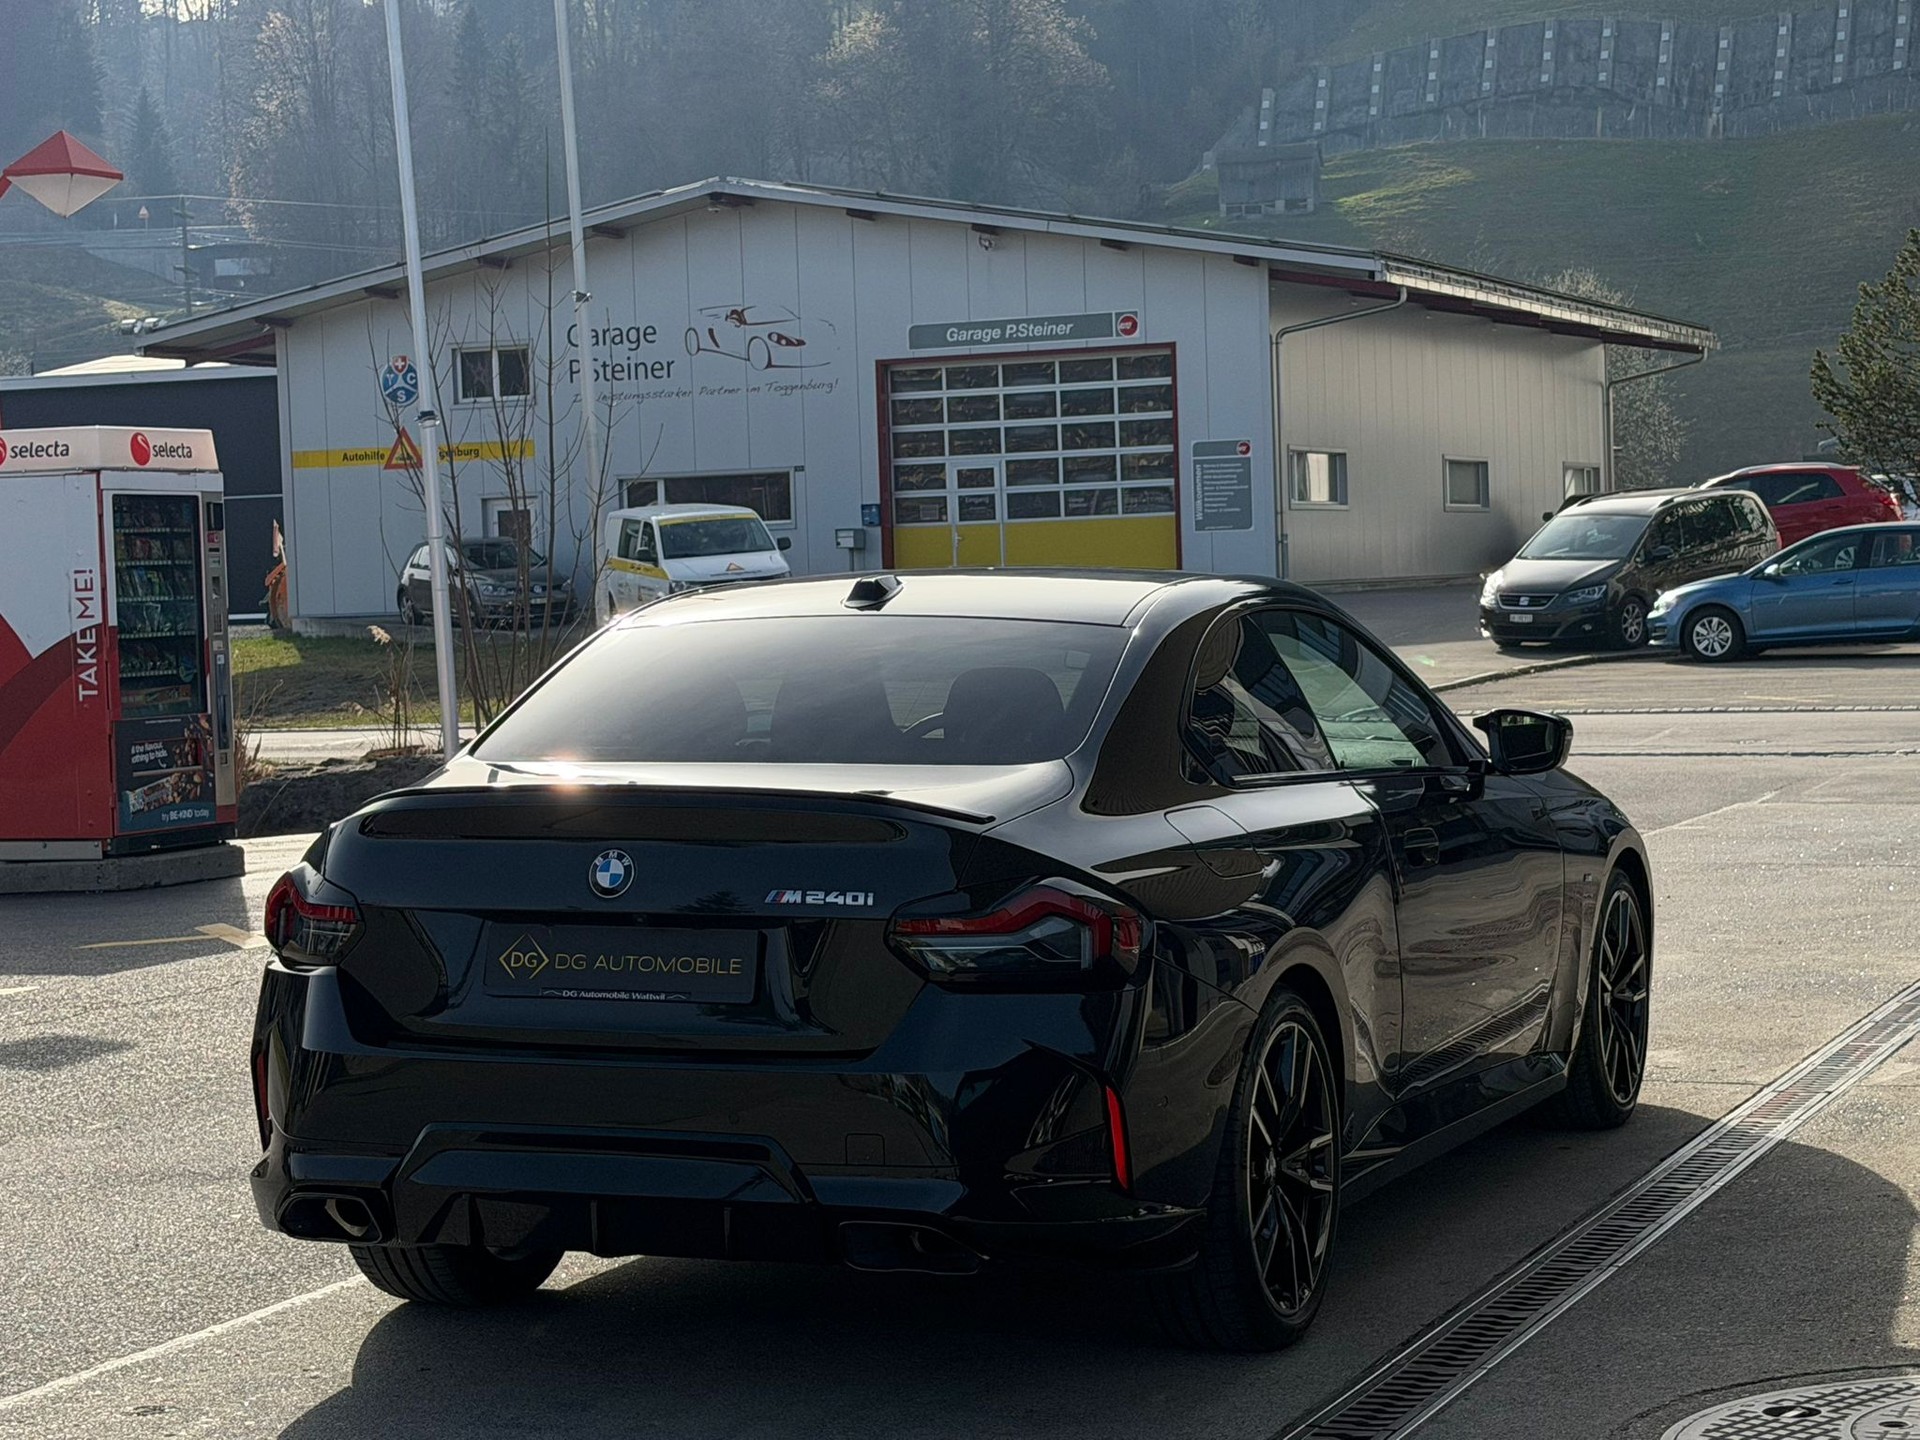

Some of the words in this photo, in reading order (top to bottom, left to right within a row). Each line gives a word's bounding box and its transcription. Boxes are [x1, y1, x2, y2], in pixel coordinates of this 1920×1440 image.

[567, 324, 657, 351] Garage
[946, 327, 1001, 342] Garage
[1005, 321, 1074, 338] P.Steiner
[765, 378, 839, 396] Toggenburg!
[9, 441, 70, 459] selecta
[152, 442, 192, 459] selecta
[342, 450, 386, 462] Autohilfe
[74, 568, 96, 619] ME!
[77, 627, 99, 702] TAKE
[510, 951, 538, 967] DG
[554, 953, 587, 970] DG
[593, 954, 743, 975] AUTOMOBILE
[562, 989, 578, 998] DG
[580, 990, 630, 999] Automobile
